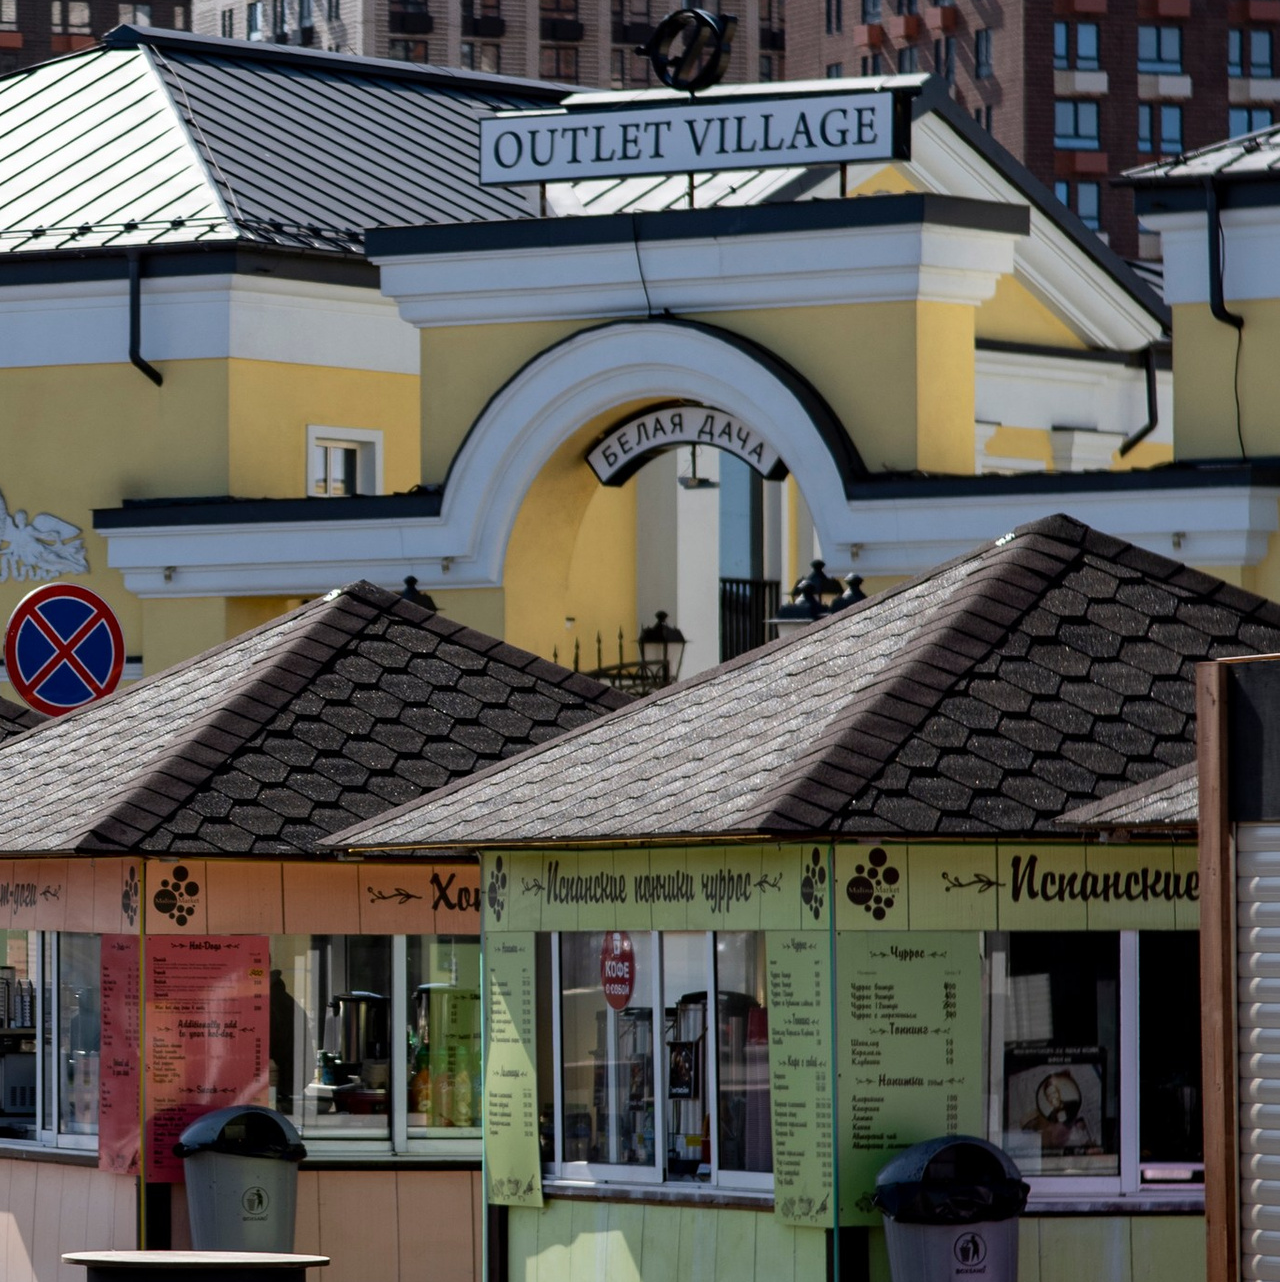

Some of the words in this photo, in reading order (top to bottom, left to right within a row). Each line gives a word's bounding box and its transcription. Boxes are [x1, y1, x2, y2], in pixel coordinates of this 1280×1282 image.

[493, 120, 671, 168] OUTLET
[684, 107, 878, 156] VILLAGE
[601, 413, 683, 467] БЕЛАЯ
[698, 415, 764, 464] ДАЧА
[1011, 854, 1199, 902] Испанские
[547, 860, 628, 904] Испанские
[634, 870, 695, 903] пончики
[701, 869, 752, 914] чуррос
[875, 885, 899, 894] Market
[178, 896, 200, 904] Market
[189, 941, 222, 952] Hot-Dogs
[890, 945, 926, 962] Чуррос
[605, 961, 629, 978] КОФЕ
[224, 1020, 238, 1029] add
[889, 1022, 929, 1035] Топпинг
[179, 1029, 186, 1038] to
[878, 1073, 924, 1087] Напитки
